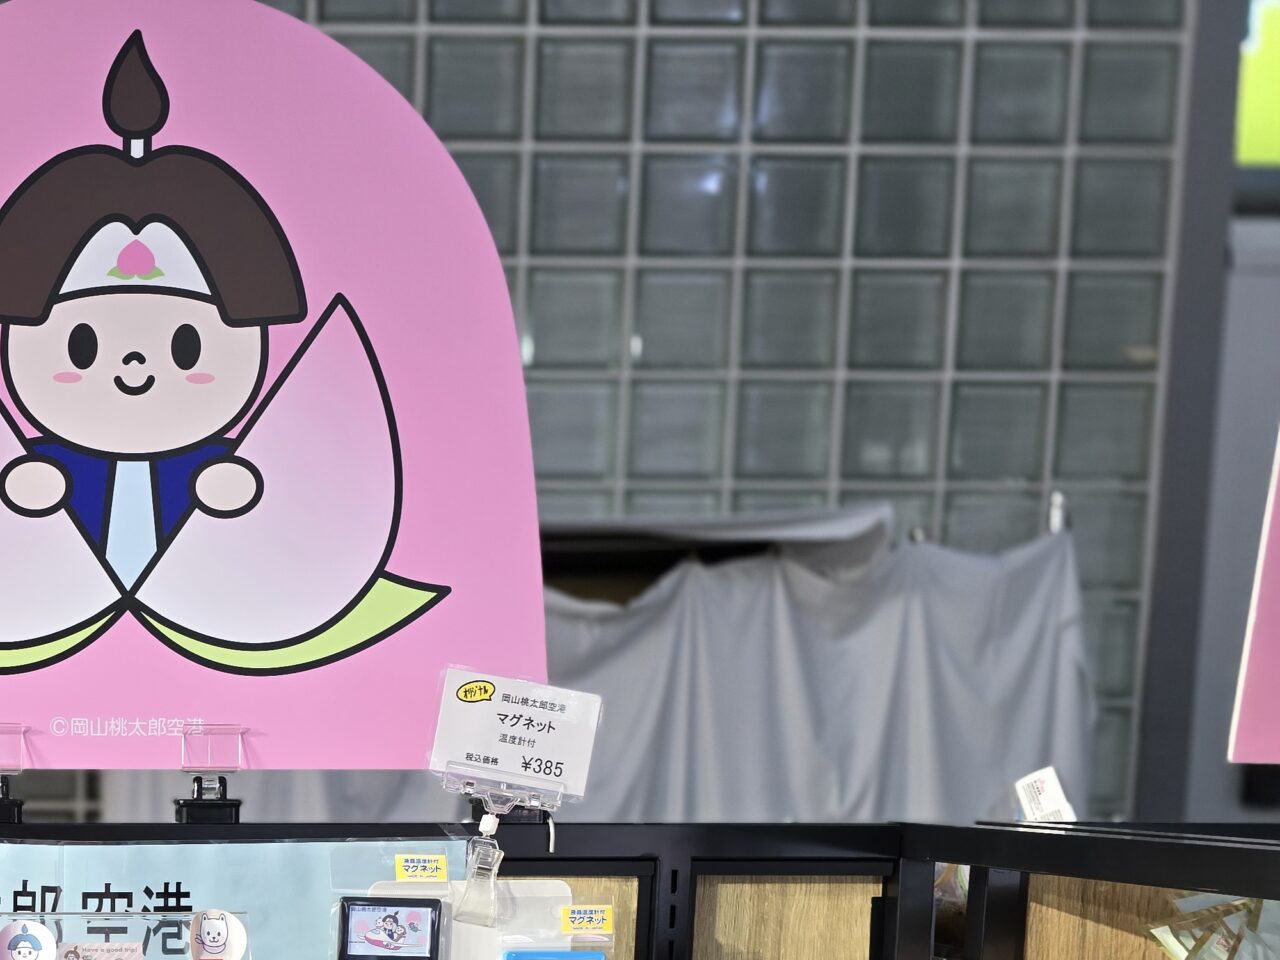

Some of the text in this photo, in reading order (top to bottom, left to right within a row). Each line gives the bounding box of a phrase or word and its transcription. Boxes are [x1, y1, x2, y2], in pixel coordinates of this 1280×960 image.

[501, 693, 567, 714] 岡山桃太郎空港
[496, 712, 556, 734] マグネット
[498, 733, 537, 748] 温度計付
[465, 752, 564, 777] 税込価格 ¥385
[402, 864, 442, 873] マグネット
[569, 916, 607, 925] マグネット
